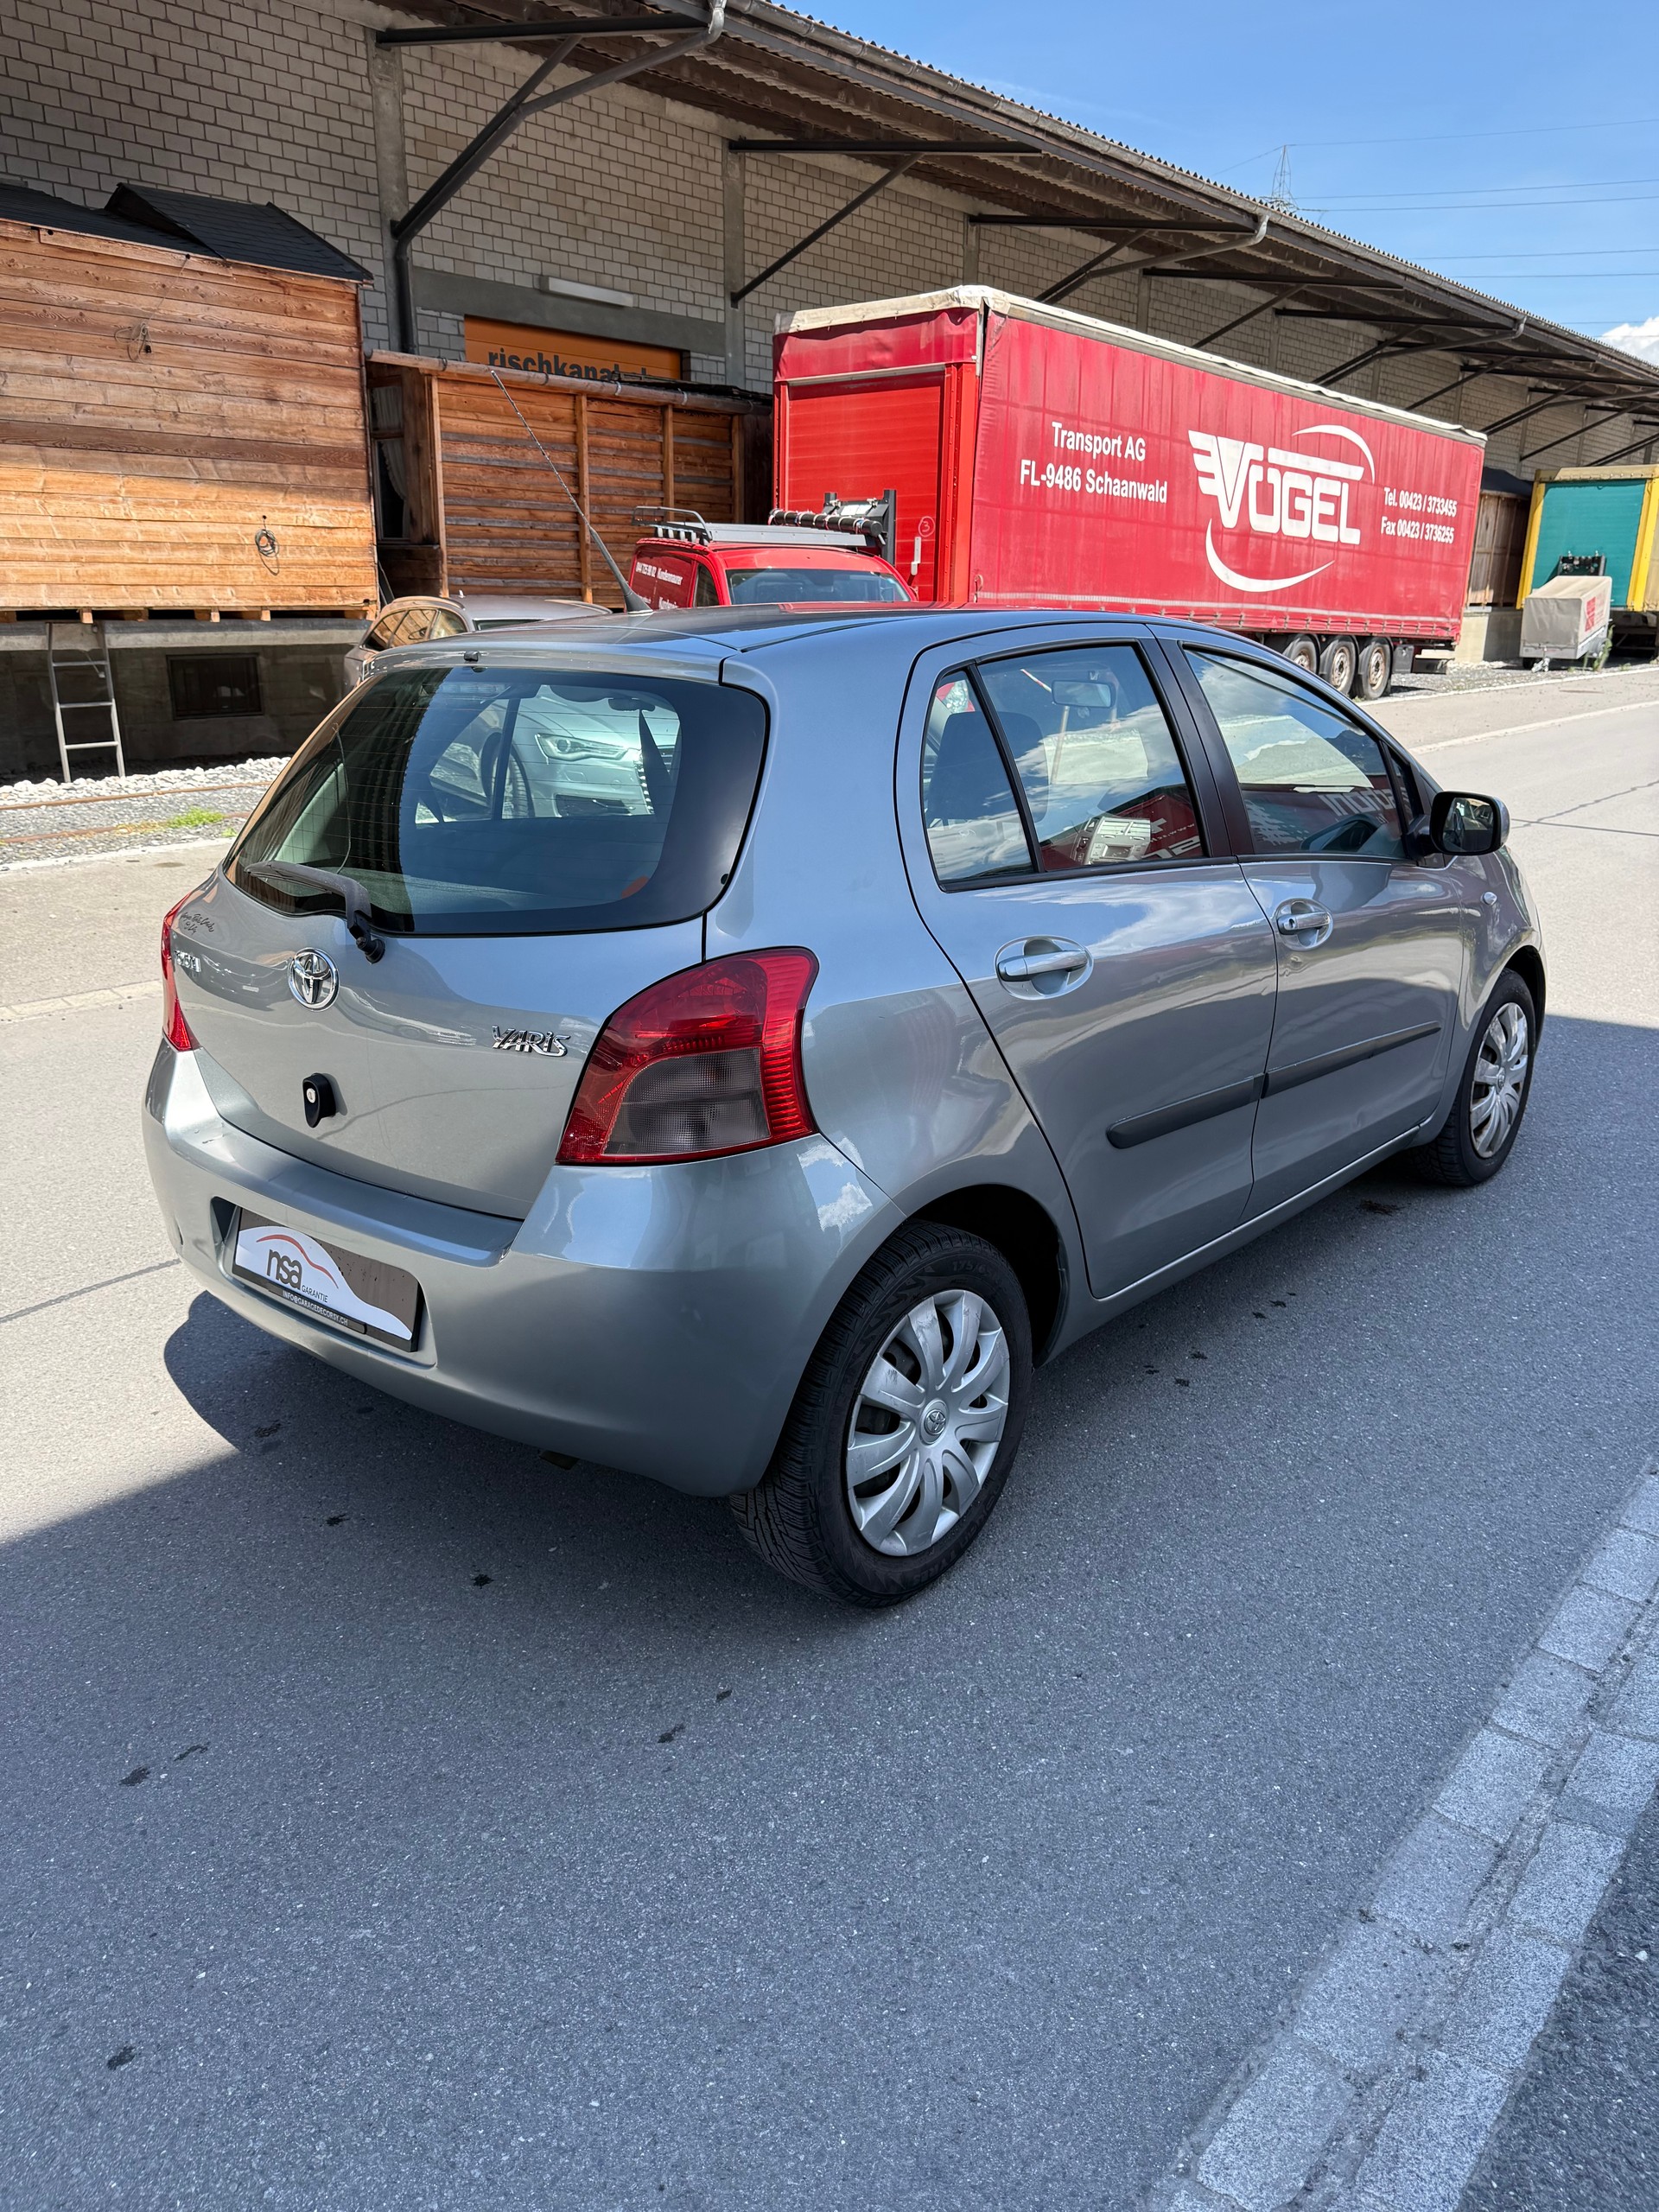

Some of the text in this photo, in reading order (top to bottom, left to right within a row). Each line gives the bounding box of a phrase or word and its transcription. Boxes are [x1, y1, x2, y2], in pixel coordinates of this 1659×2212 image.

[1052, 421, 1146, 461] Transport AG
[1020, 459, 1168, 504] FL-9486 Schaanwald
[1383, 486, 1398, 506] Tel.
[1399, 490, 1422, 512] 00423
[1381, 516, 1396, 536] Fax
[1397, 518, 1420, 539] 00423
[266, 1249, 302, 1291] nsa
[301, 1284, 329, 1303] GARANTIE
